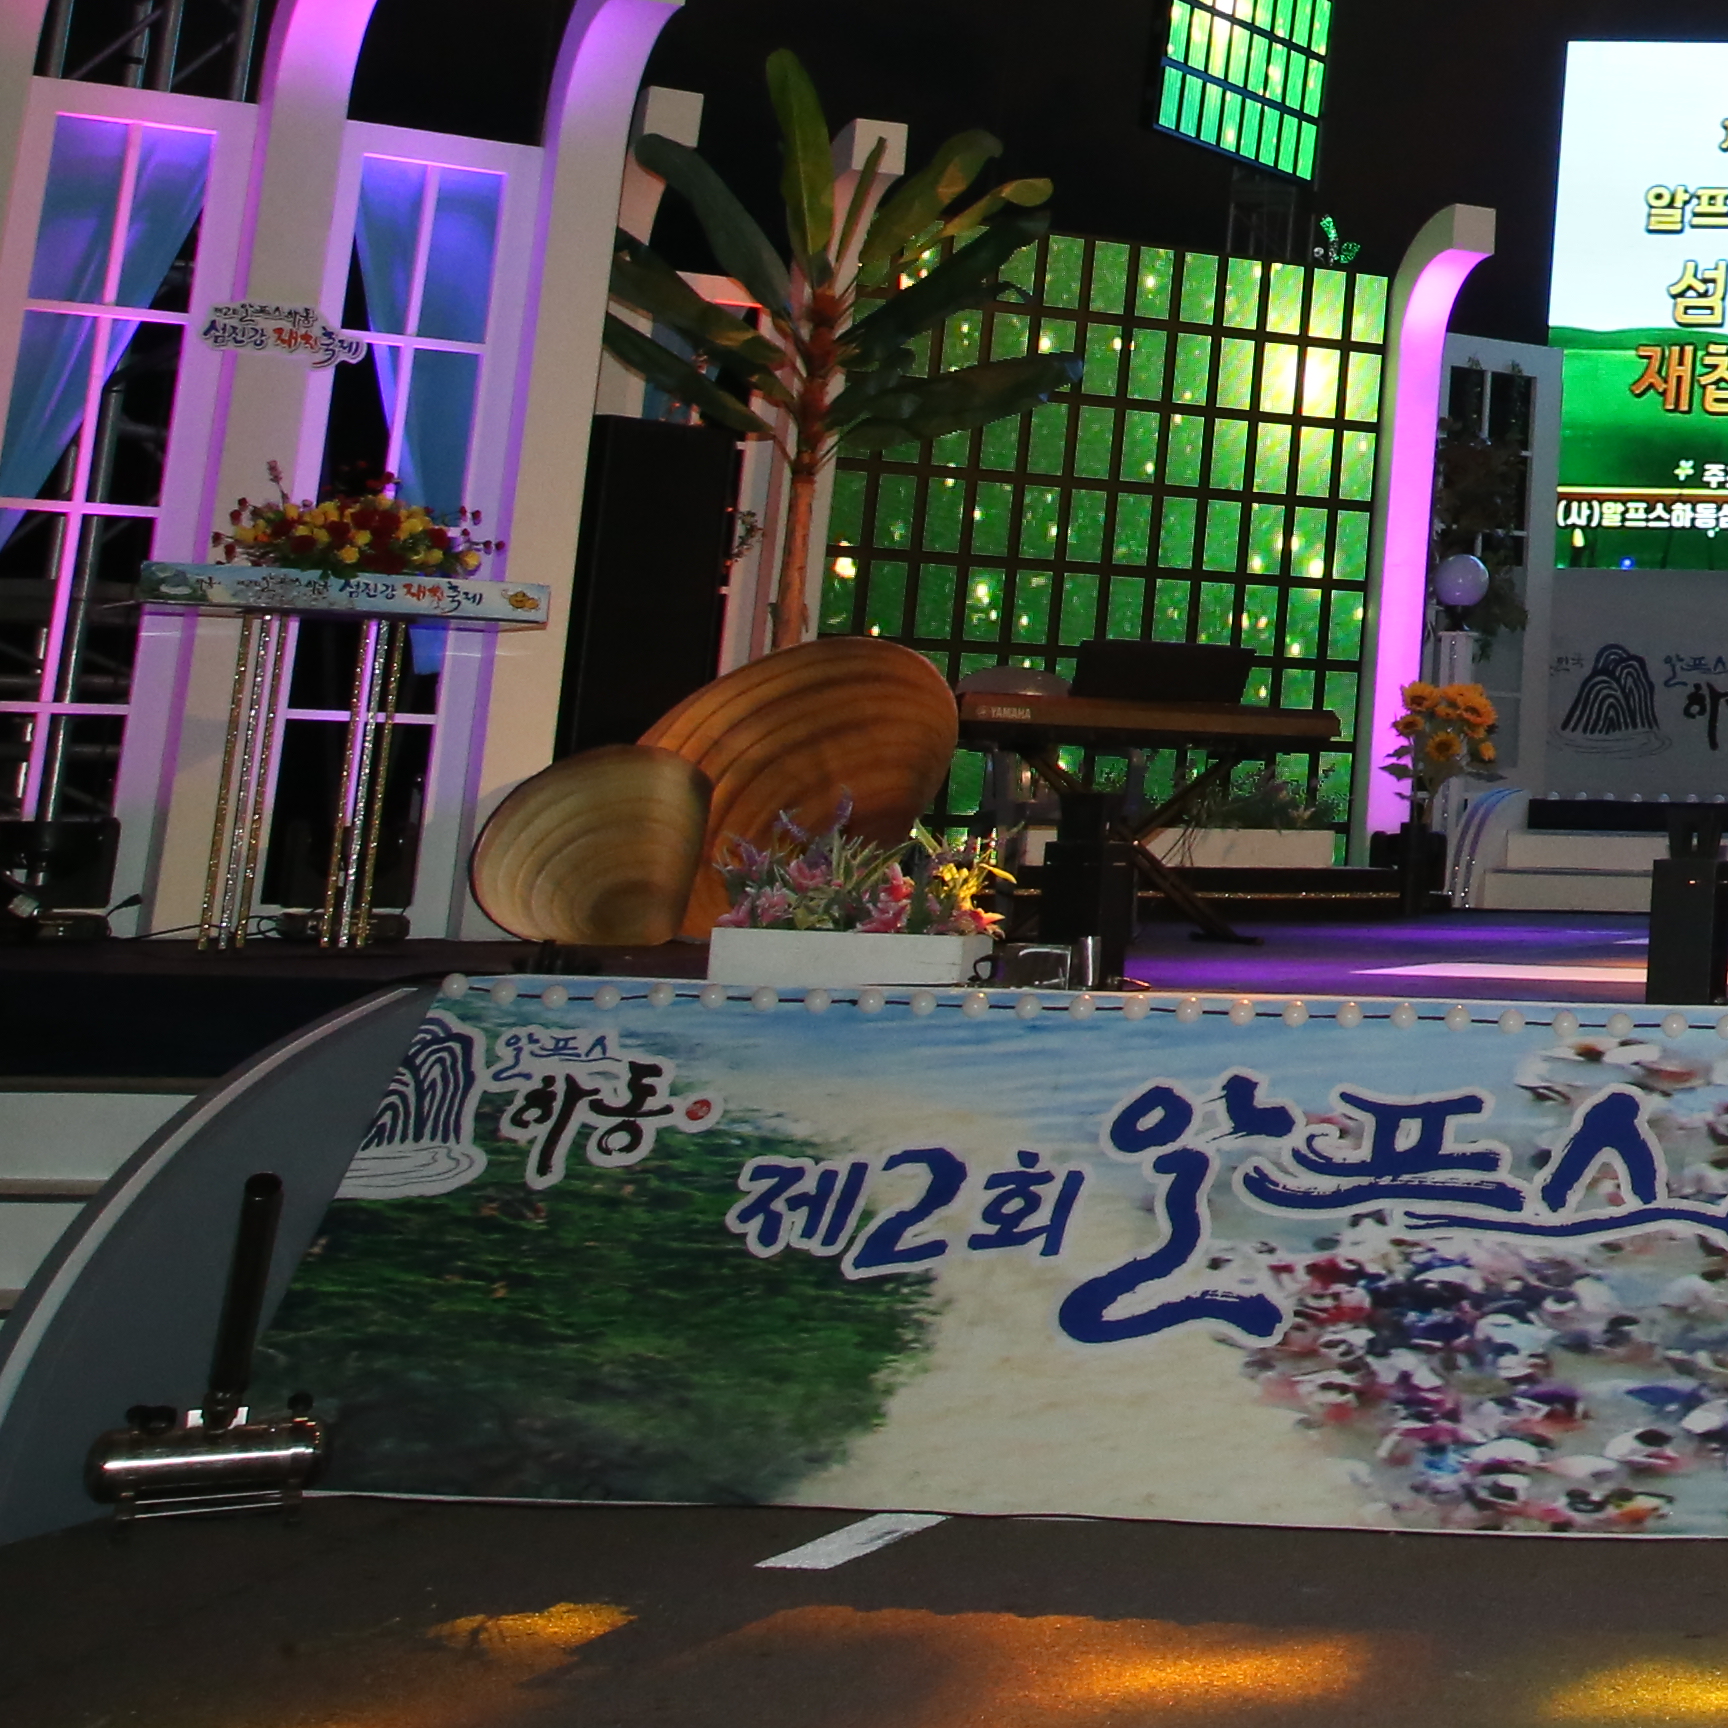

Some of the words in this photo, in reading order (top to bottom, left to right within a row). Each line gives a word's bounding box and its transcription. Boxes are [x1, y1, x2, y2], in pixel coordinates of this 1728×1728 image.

[203, 319, 268, 348] 섬진강
[990, 706, 1032, 720] YAMAHA
[492, 1032, 622, 1082] 알프스
[510, 1060, 674, 1177] 하동
[740, 1147, 1084, 1271] 제2회
